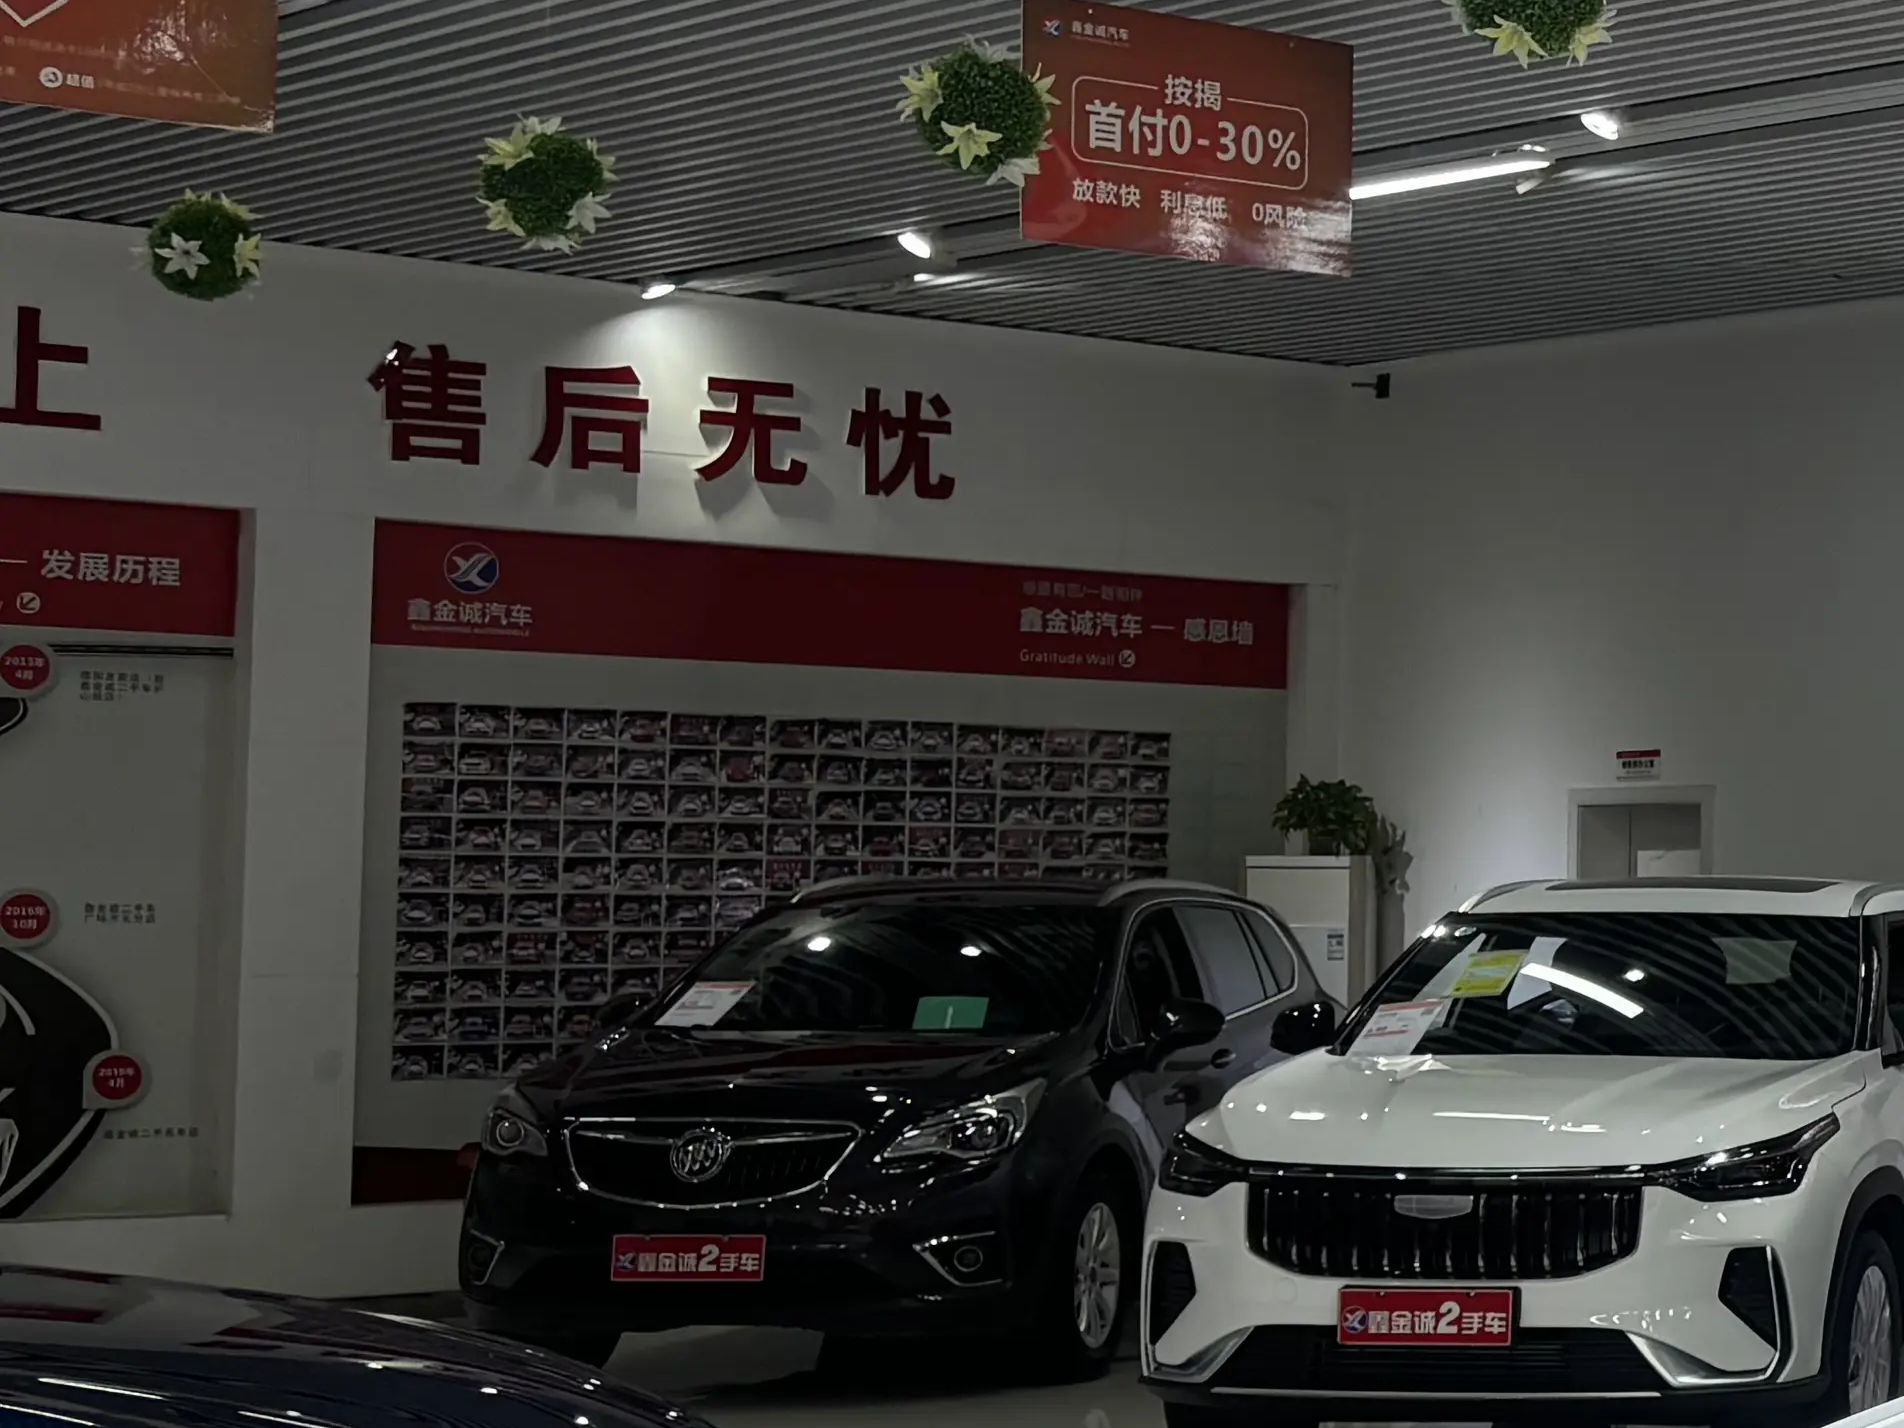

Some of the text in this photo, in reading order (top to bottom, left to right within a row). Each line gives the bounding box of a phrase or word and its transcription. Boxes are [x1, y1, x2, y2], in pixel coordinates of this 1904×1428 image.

[1164, 74, 1222, 111] 按揭
[1085, 99, 1301, 171] 首付0-30%
[1072, 177, 1308, 230] 放款快 利息低 0风险
[0, 305, 102, 431] 上
[367, 341, 956, 501] 售后无忧
[40, 549, 181, 587] 发展历程
[407, 597, 533, 627] 鑫金诚汽车
[1019, 606, 1254, 646] 鑫金诚汽车 感恩墙
[1019, 649, 1115, 668] Gratitude Wall
[637, 1244, 760, 1272] 鑫金诚2手车
[1367, 1300, 1508, 1335] 鑫金诚2手车
